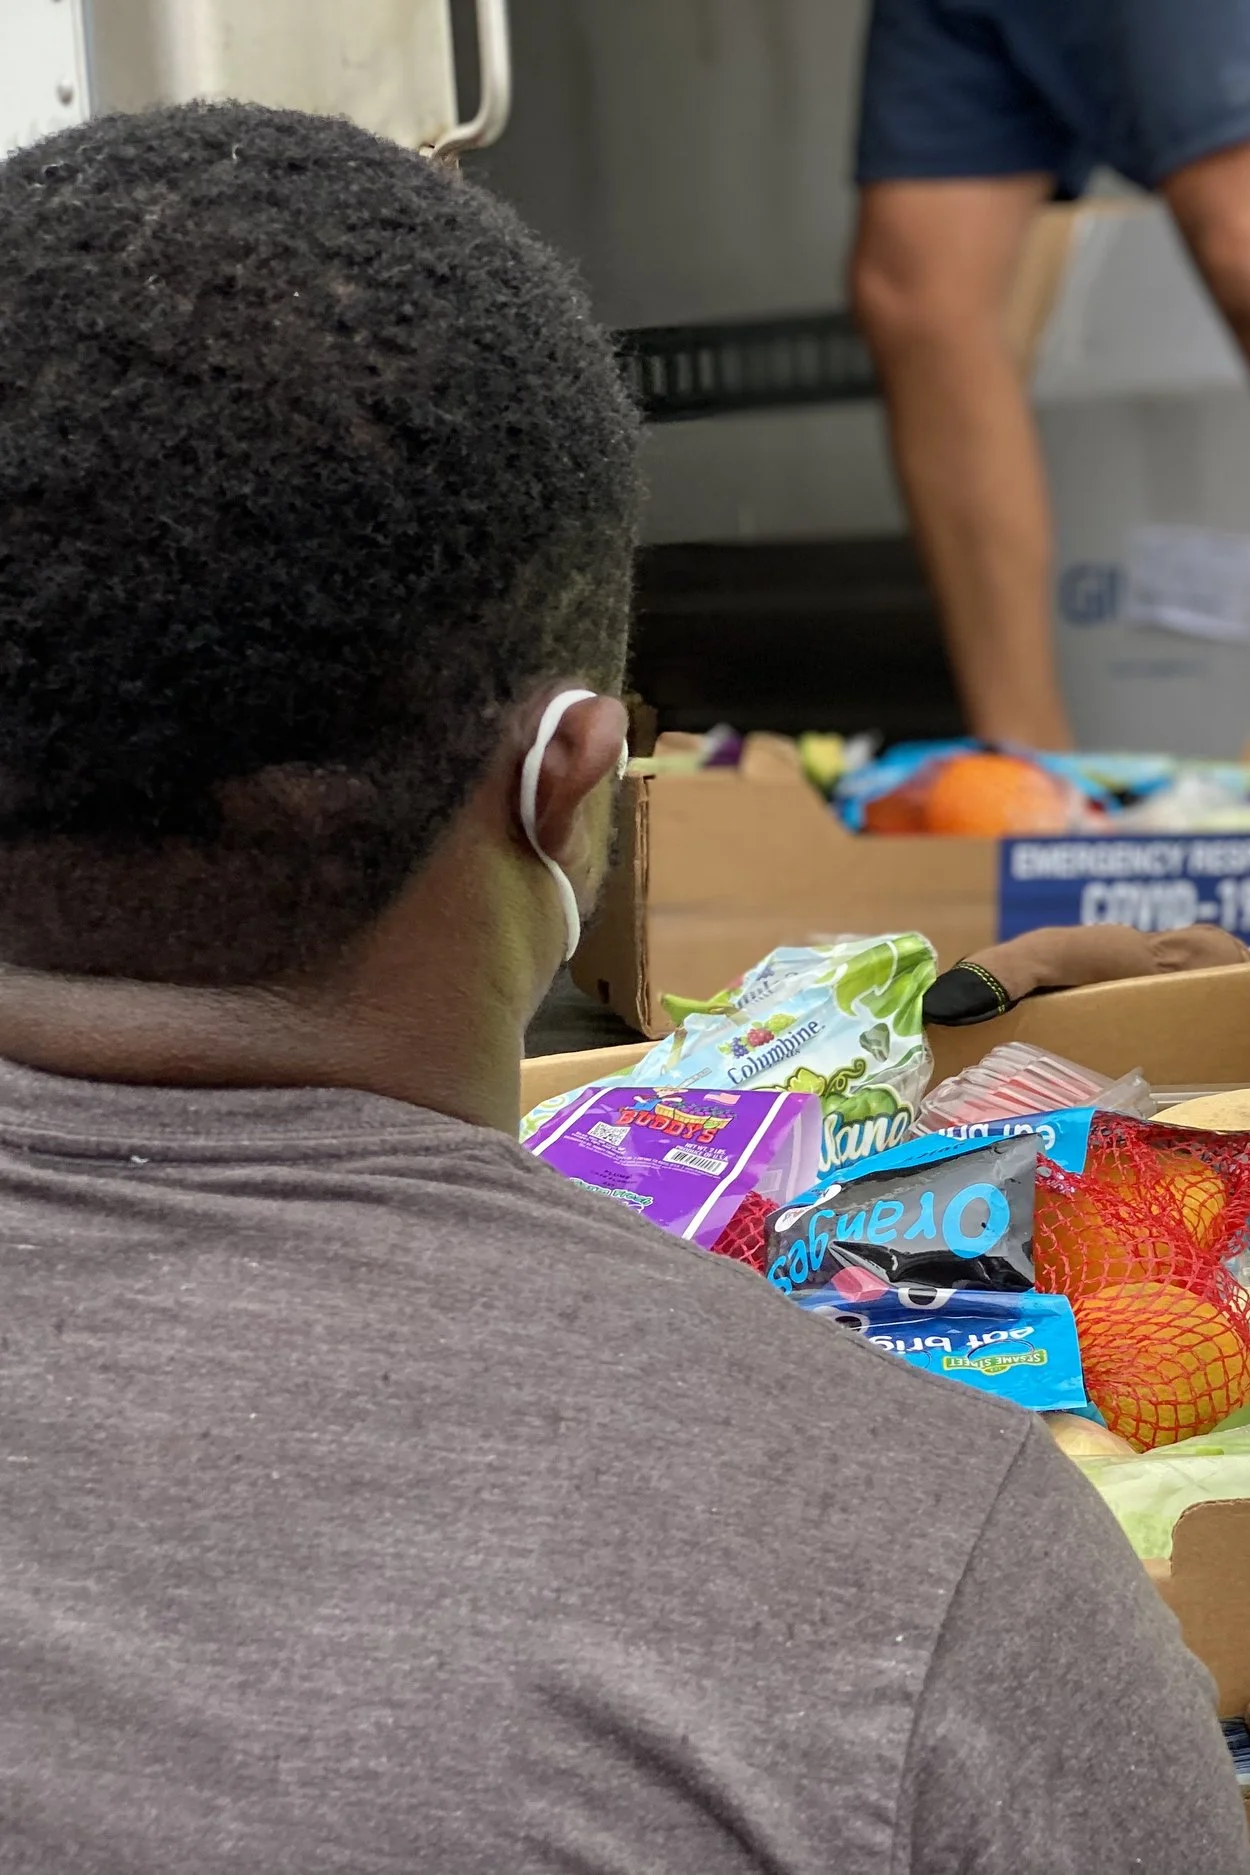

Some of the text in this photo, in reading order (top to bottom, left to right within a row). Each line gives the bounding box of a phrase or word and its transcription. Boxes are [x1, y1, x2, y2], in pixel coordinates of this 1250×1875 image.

[1010, 840, 1185, 880] EMERGENCY
[727, 1020, 819, 1085] Columbine
[614, 1108, 721, 1144] BUDDYS
[767, 1182, 1010, 1296] Oranges
[868, 1326, 1035, 1354] eat brig
[949, 1353, 1041, 1368] SESAME STREET
